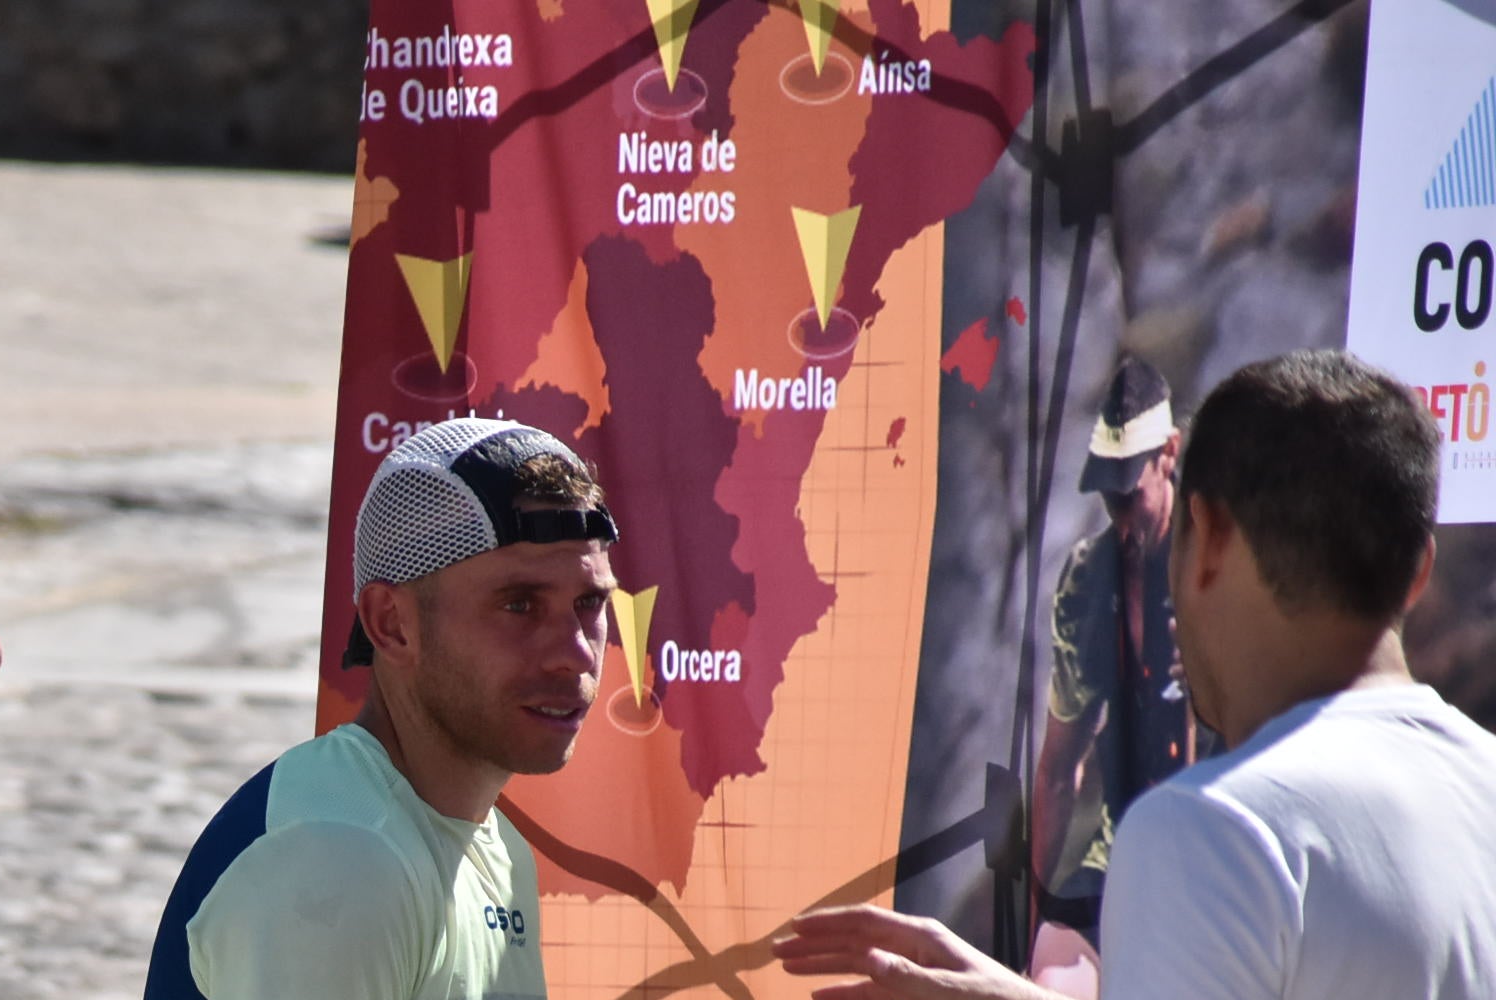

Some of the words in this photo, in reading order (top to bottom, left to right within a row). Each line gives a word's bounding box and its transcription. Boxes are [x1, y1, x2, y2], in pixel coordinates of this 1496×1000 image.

[858, 54, 932, 95] Aínsa
[400, 76, 498, 124] Queixa
[617, 132, 693, 174] Nieva
[701, 130, 736, 172] de
[616, 183, 736, 225] Cameros
[733, 367, 837, 411] Morella
[660, 640, 741, 682] Orcera
